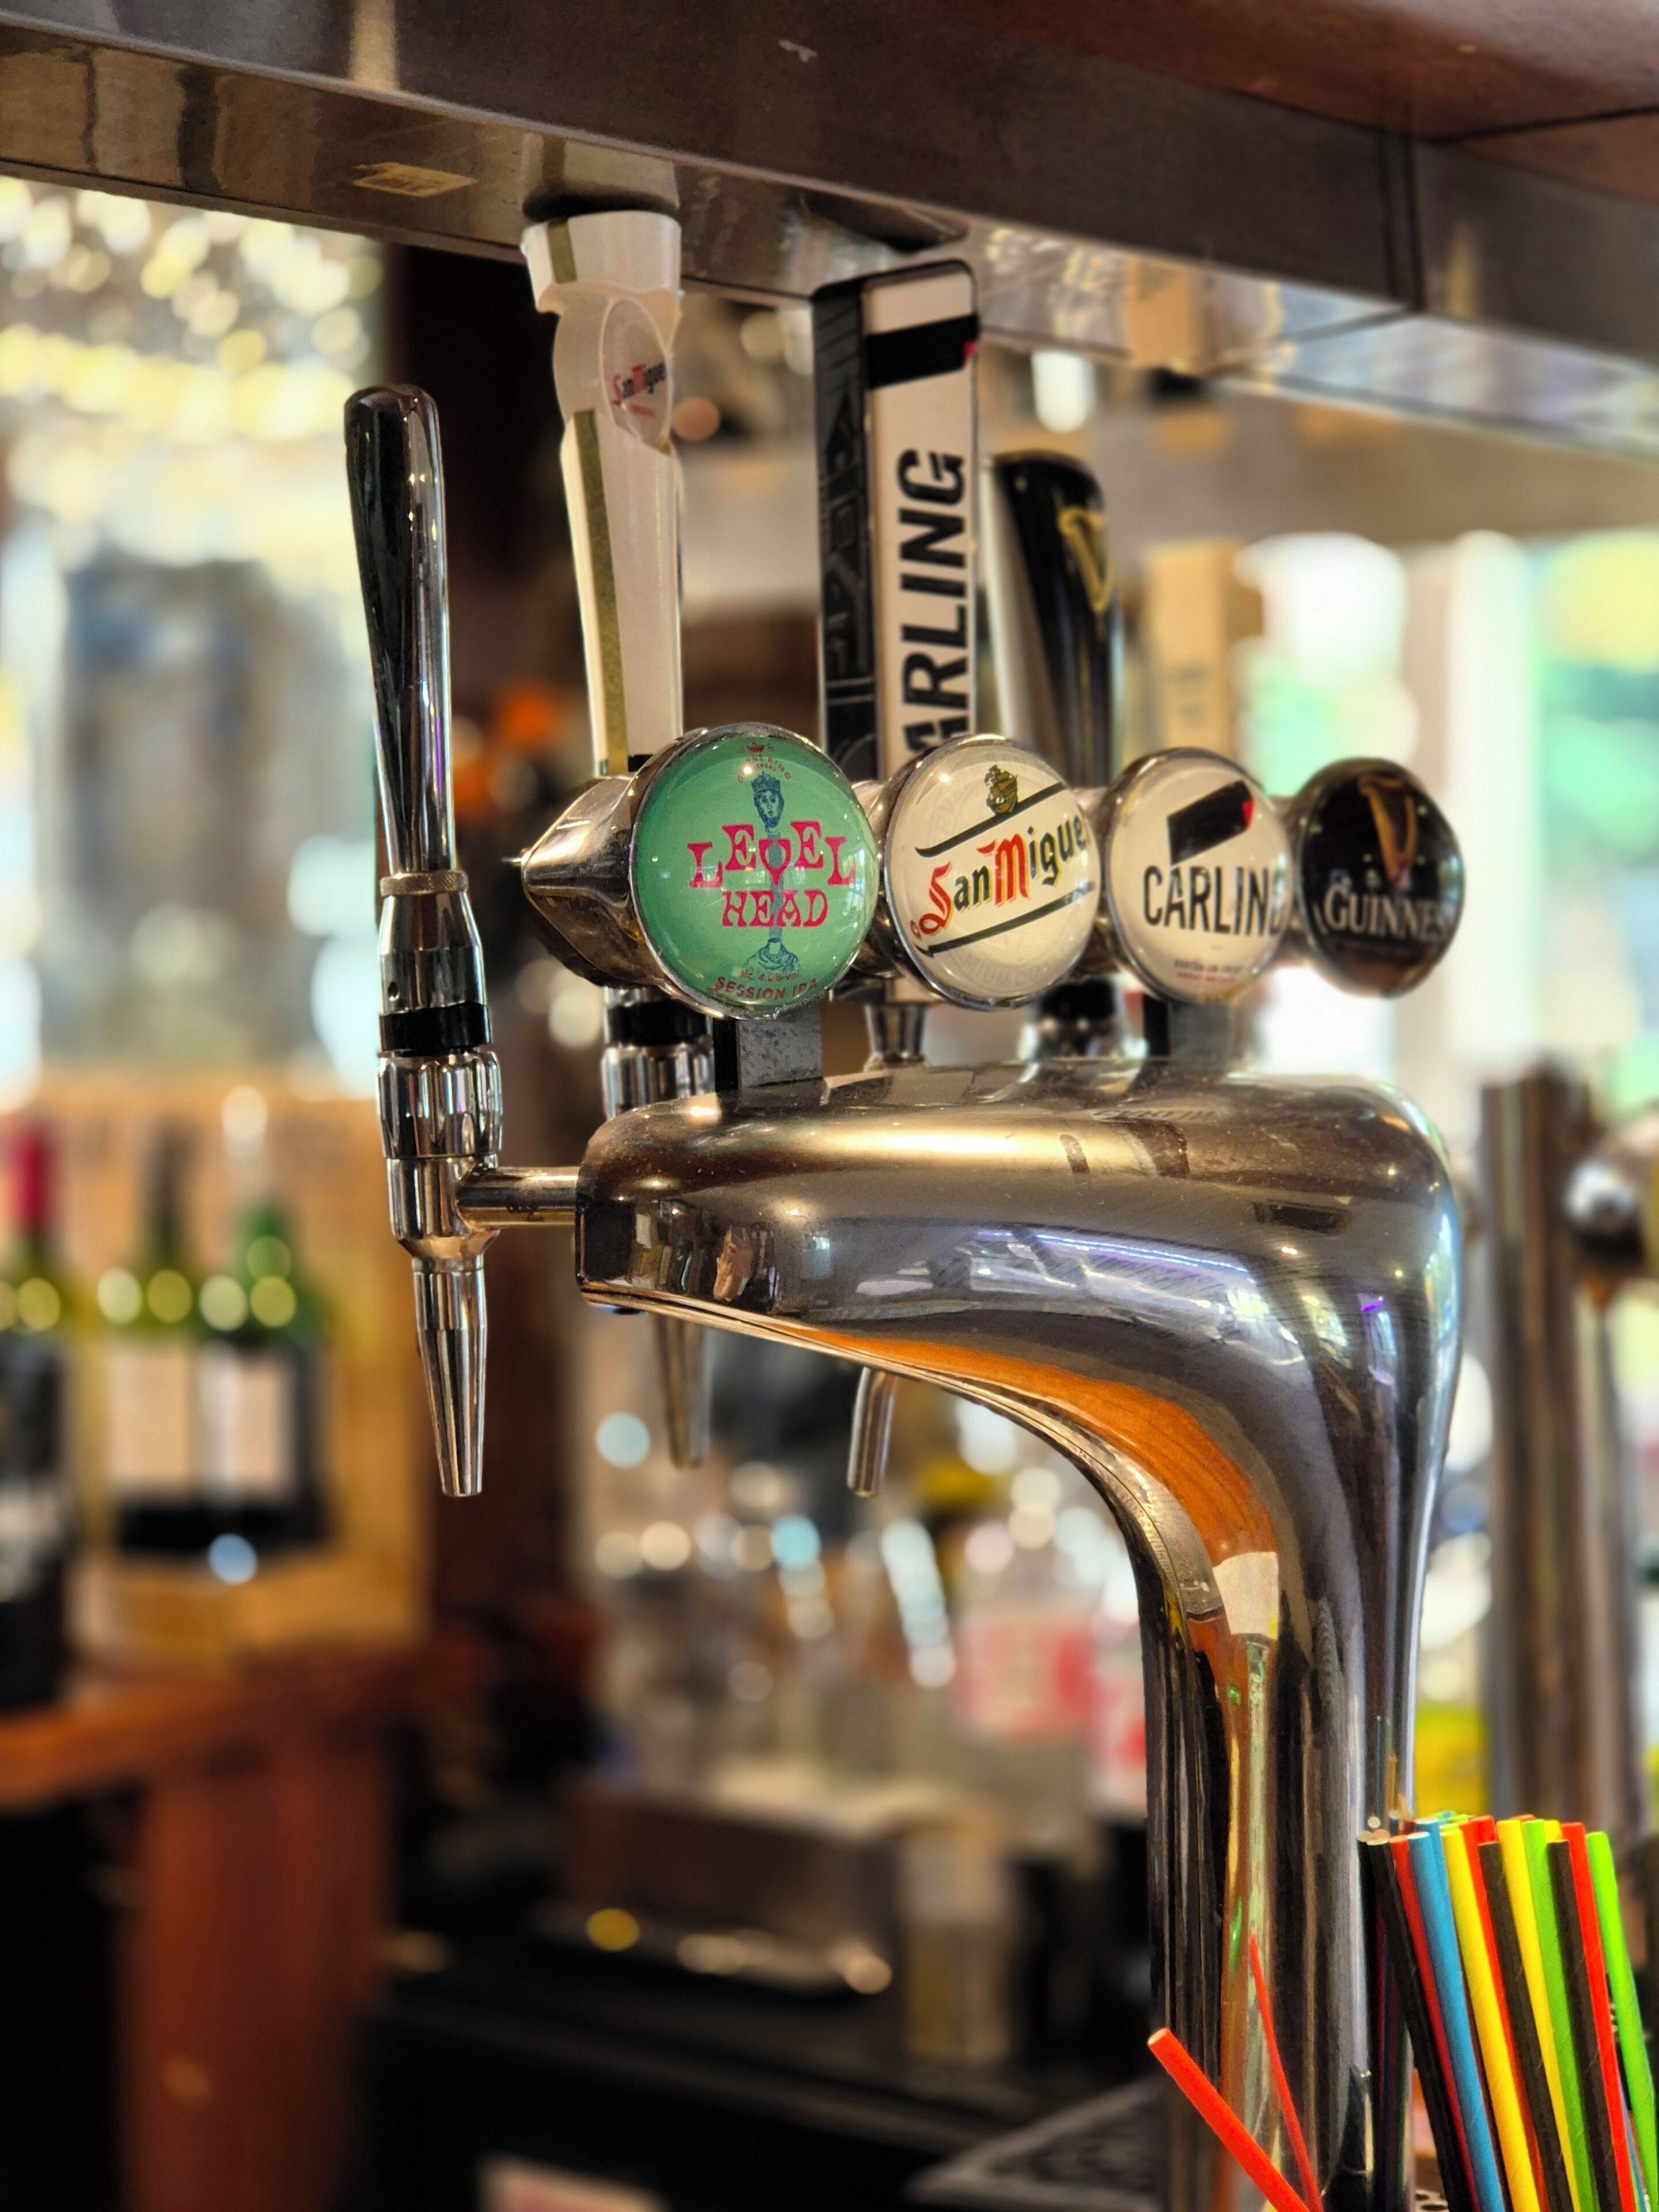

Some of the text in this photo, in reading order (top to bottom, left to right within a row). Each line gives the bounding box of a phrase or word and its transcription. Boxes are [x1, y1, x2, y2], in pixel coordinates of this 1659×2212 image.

[896, 449, 969, 751] ARLING
[687, 821, 856, 889] LEVEL
[722, 889, 829, 928] HEAD
[708, 976, 817, 1000] SESSION IPA
